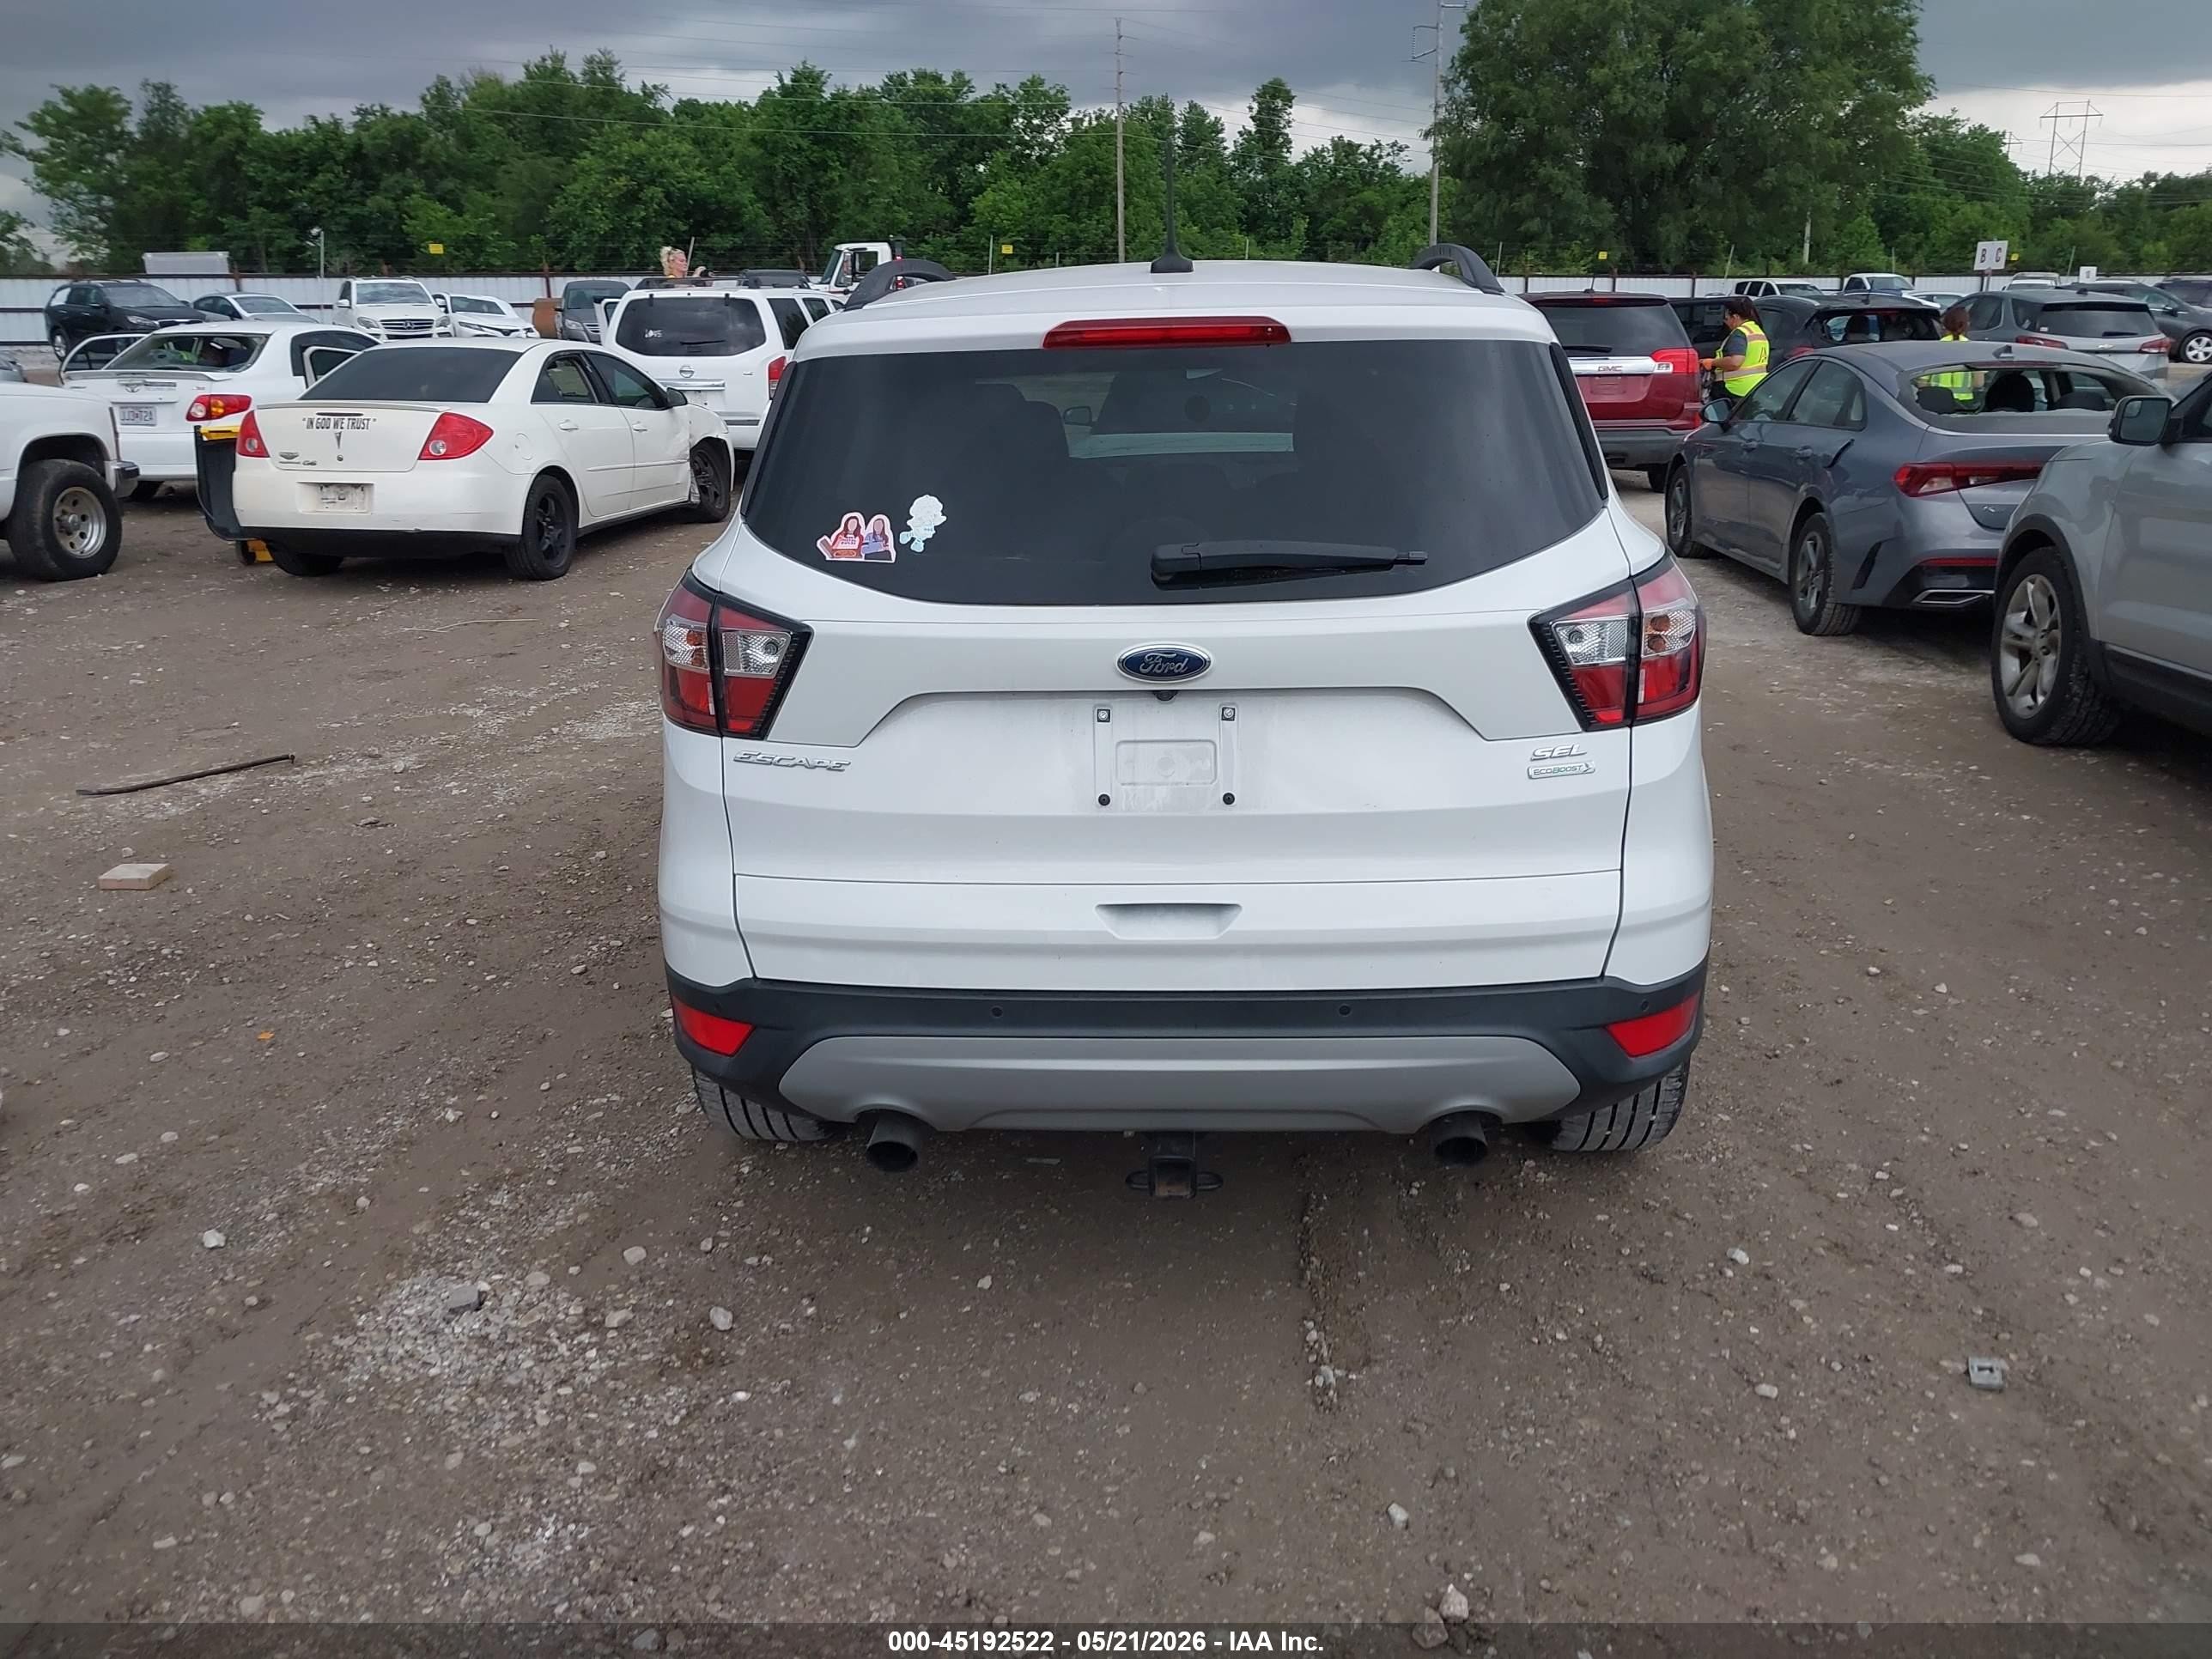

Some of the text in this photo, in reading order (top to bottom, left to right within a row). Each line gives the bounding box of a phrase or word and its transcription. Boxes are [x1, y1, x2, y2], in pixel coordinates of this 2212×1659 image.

[1979, 248, 1987, 264] B
[315, 417, 331, 429] GOD
[333, 417, 344, 429] WE
[1139, 653, 1189, 673] Ford
[732, 750, 851, 772] ESCAPE
[1530, 744, 1588, 762] SEL
[1533, 764, 1584, 775] ECOBOOST
